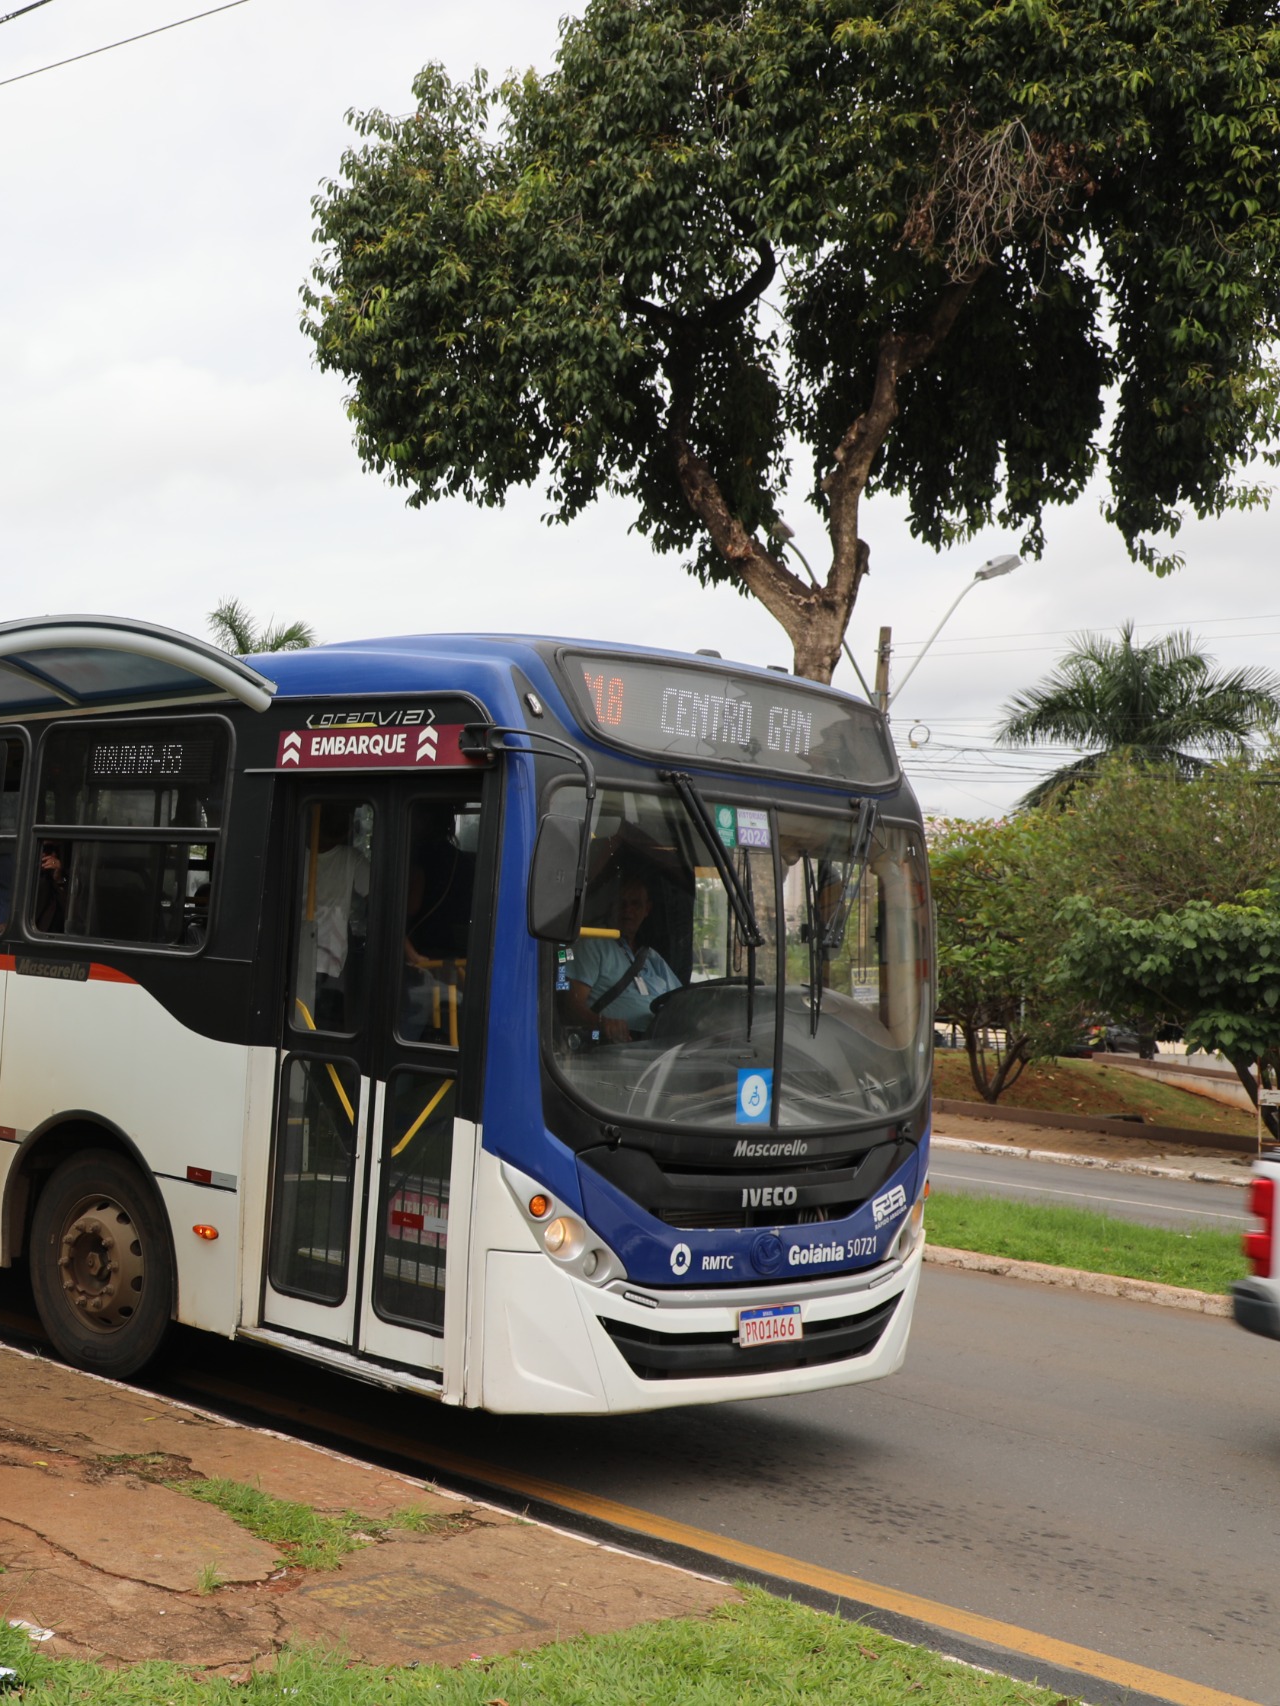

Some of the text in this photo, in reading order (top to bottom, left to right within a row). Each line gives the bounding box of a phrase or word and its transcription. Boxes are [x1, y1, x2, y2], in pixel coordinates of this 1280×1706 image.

[660, 687, 753, 746] CENTRO
[767, 706, 813, 755] GYN
[310, 733, 407, 756] EMBARQUE
[740, 828, 769, 846] 2024
[18, 959, 86, 979] Mascarello
[733, 1139, 808, 1157] Mascarello
[742, 1186, 797, 1207] IVECO
[847, 1235, 877, 1258] 50721
[702, 1255, 734, 1270] RMTC
